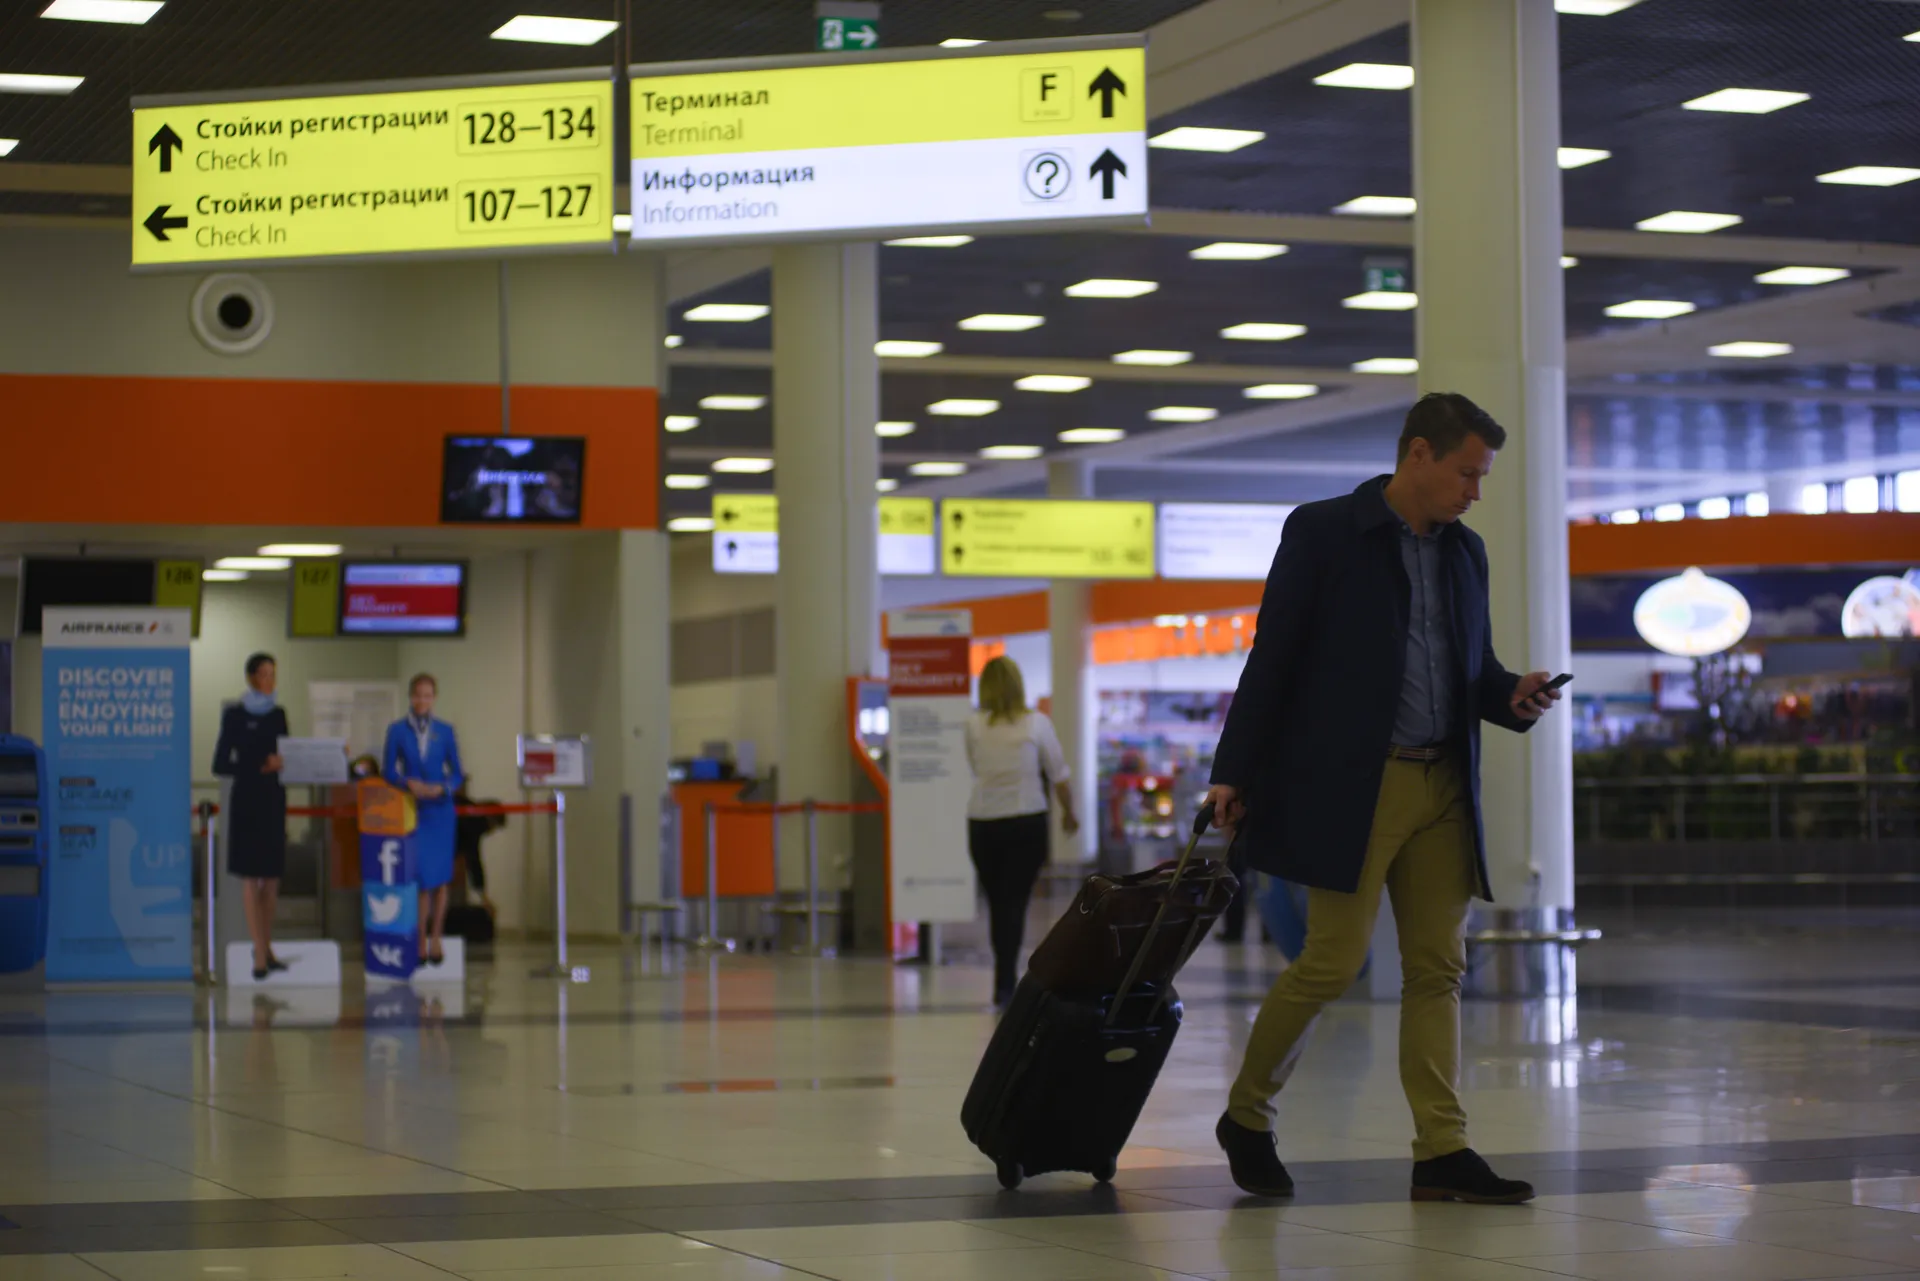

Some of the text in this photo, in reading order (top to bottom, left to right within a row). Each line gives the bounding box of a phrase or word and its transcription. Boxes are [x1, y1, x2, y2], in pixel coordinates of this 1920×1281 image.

[1040, 73, 1058, 101] F
[642, 89, 770, 116] Терминал
[196, 110, 449, 139] Стойки регистрации
[642, 118, 744, 146] Terminal
[195, 146, 288, 172] Check In
[643, 166, 815, 194] Информация
[196, 187, 449, 215] Стойки регистрации
[643, 198, 779, 224] Information
[195, 223, 287, 248] Check In
[302, 567, 330, 586] 127
[60, 621, 146, 634] AIRFRANCE
[59, 667, 174, 687] DISCOVER
[59, 688, 71, 700] A
[75, 688, 111, 700] NEW
[114, 688, 151, 700] WAY
[59, 702, 174, 720] ENJOYING
[60, 721, 173, 737] YOUR FLIGHT
[142, 843, 186, 869] UP
